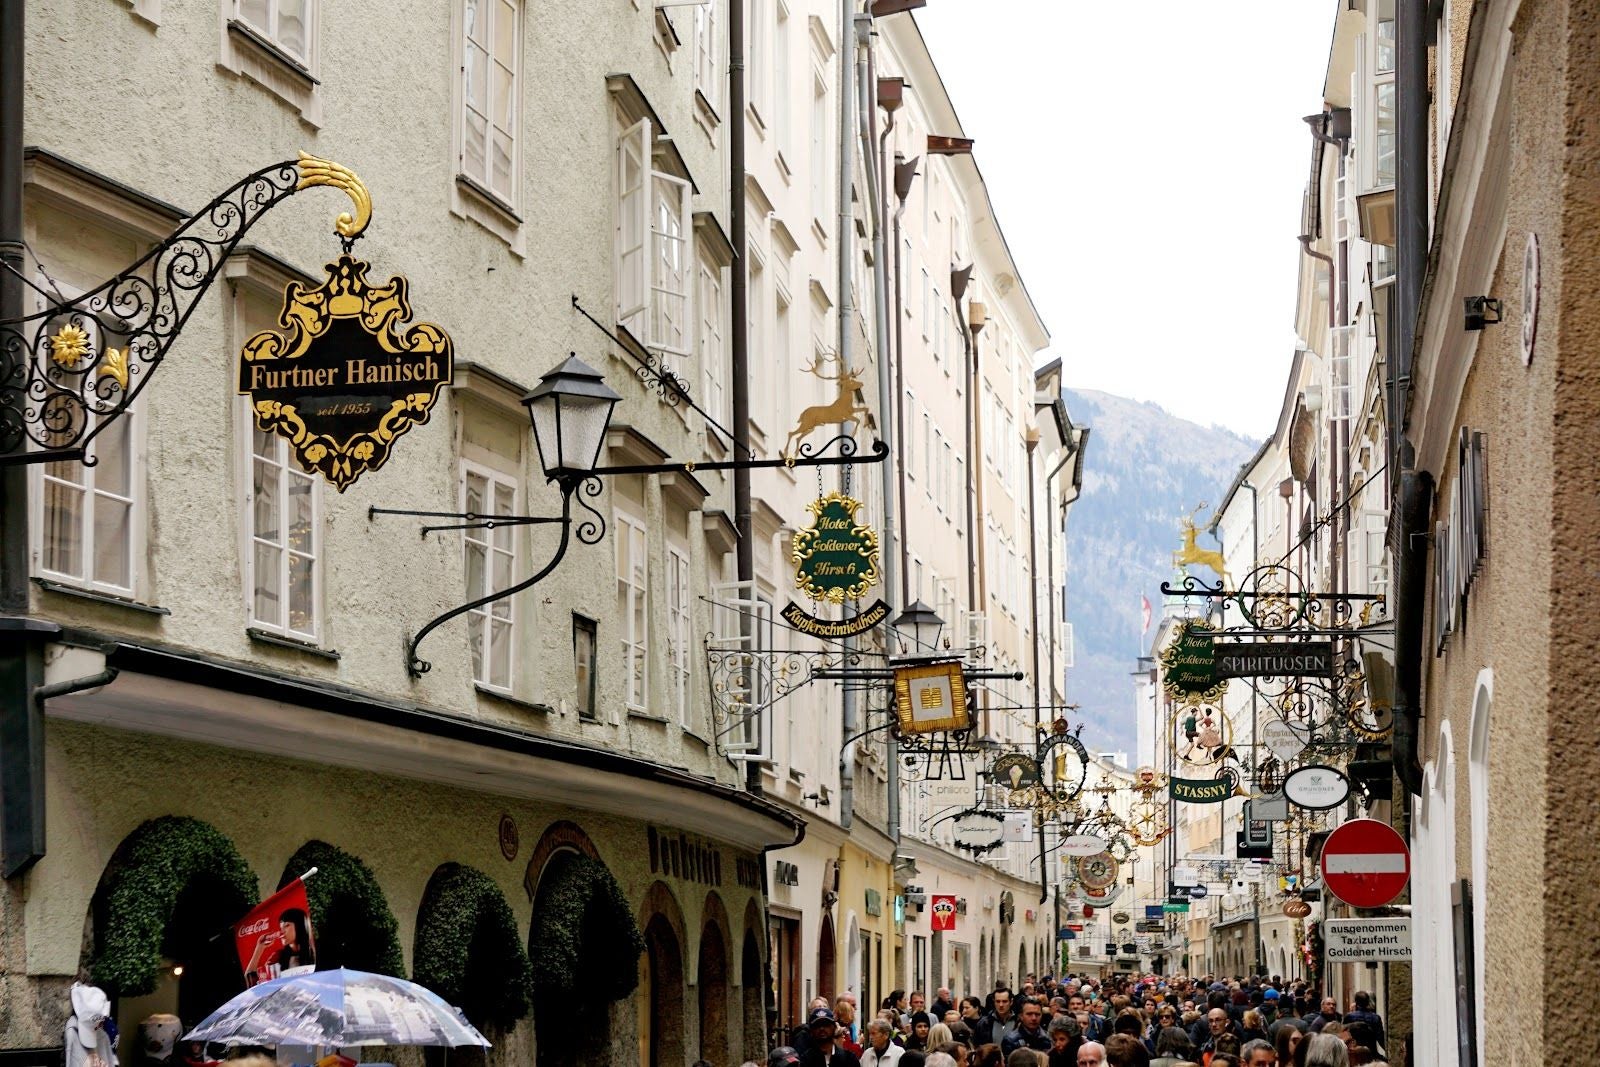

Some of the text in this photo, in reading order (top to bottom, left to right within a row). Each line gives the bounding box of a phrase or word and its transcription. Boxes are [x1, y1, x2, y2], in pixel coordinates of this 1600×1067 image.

[249, 355, 439, 390] Furtner Hanisch
[316, 402, 371, 416] seit 1955
[818, 516, 851, 530] Hotel
[812, 539, 861, 552] Goldener
[813, 561, 855, 576] Hirsch
[785, 605, 886, 636] Kupferschmiedhaus
[1185, 637, 1210, 648] Hotel
[1177, 654, 1215, 665] Goldener
[1222, 655, 1325, 672] SPIRITUOSEN
[1179, 672, 1211, 683] Hirsch
[1039, 735, 1085, 757] SALAMANDER
[937, 785, 970, 797] philoro
[1174, 783, 1227, 798] STASSNY
[1331, 924, 1407, 934] ausgenommen
[1340, 935, 1398, 945] Taxizufahrt
[1328, 947, 1412, 957] Goldener Hirsch
